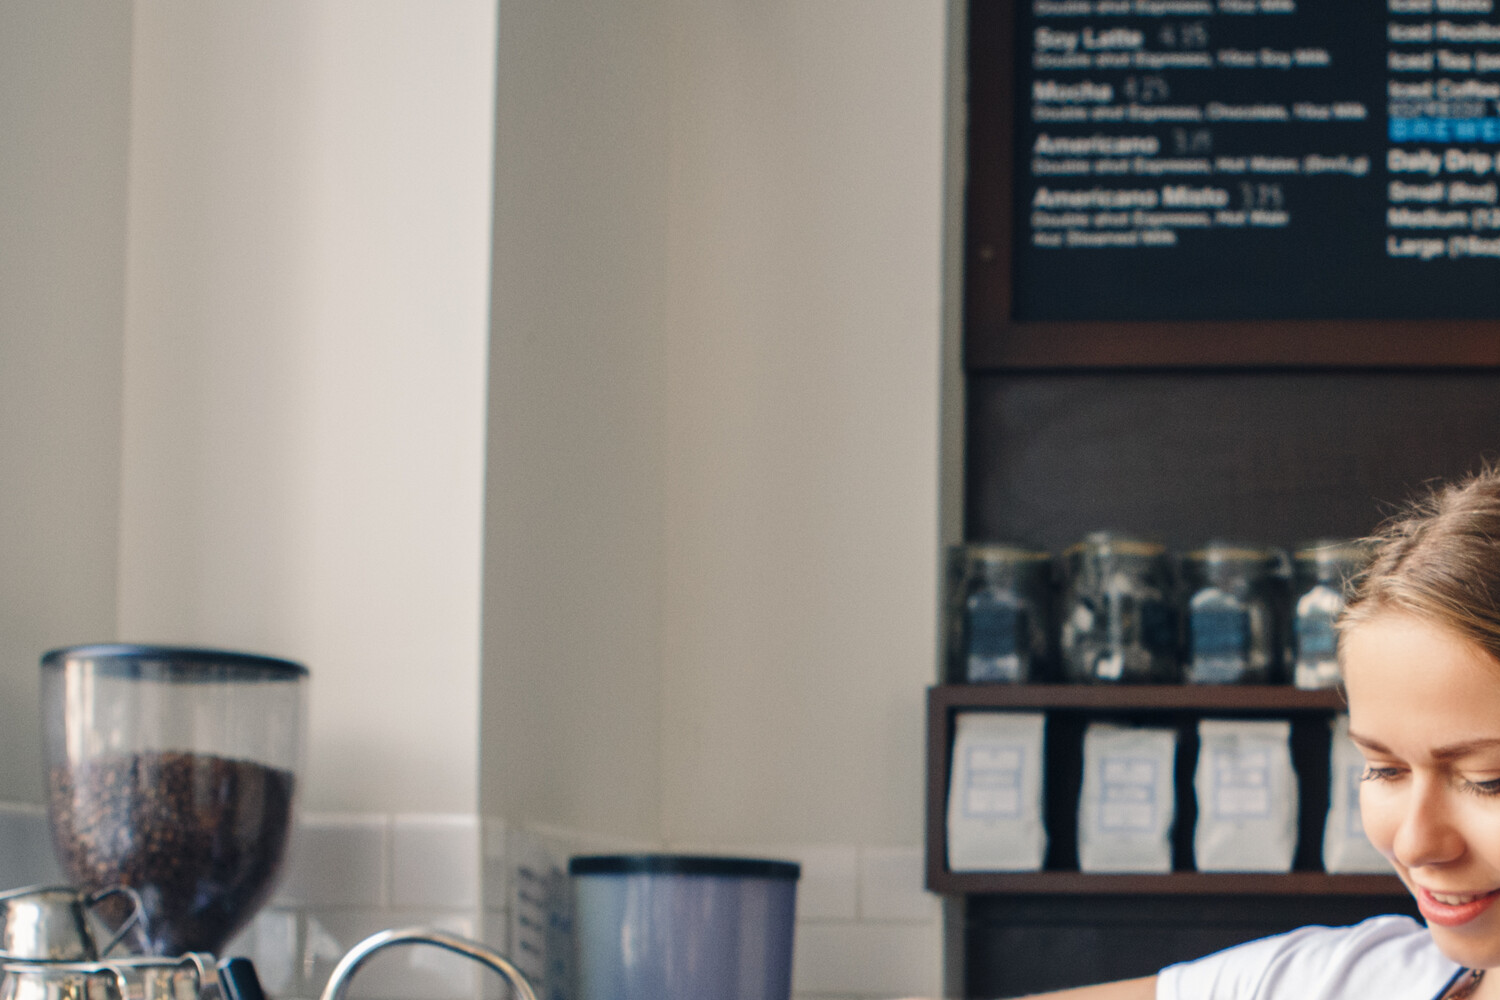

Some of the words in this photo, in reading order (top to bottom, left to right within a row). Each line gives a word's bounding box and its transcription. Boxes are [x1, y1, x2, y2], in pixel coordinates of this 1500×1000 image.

[1035, 29, 1079, 51] Soy
[1082, 29, 1143, 50] Latte
[1388, 24, 1433, 42] Iced
[1388, 53, 1434, 71] Iced
[1437, 50, 1472, 72] Tea
[1033, 82, 1113, 104] Mocha
[1388, 82, 1434, 99] Iced
[1034, 135, 1159, 156] Americano
[1388, 150, 1442, 174] Daily
[1445, 150, 1492, 174] Drip
[1034, 189, 1159, 210] Americano
[1161, 187, 1228, 208] Misto
[1389, 182, 1445, 203] Small
[1388, 209, 1469, 228] Medium
[1387, 238, 1445, 259] Large
